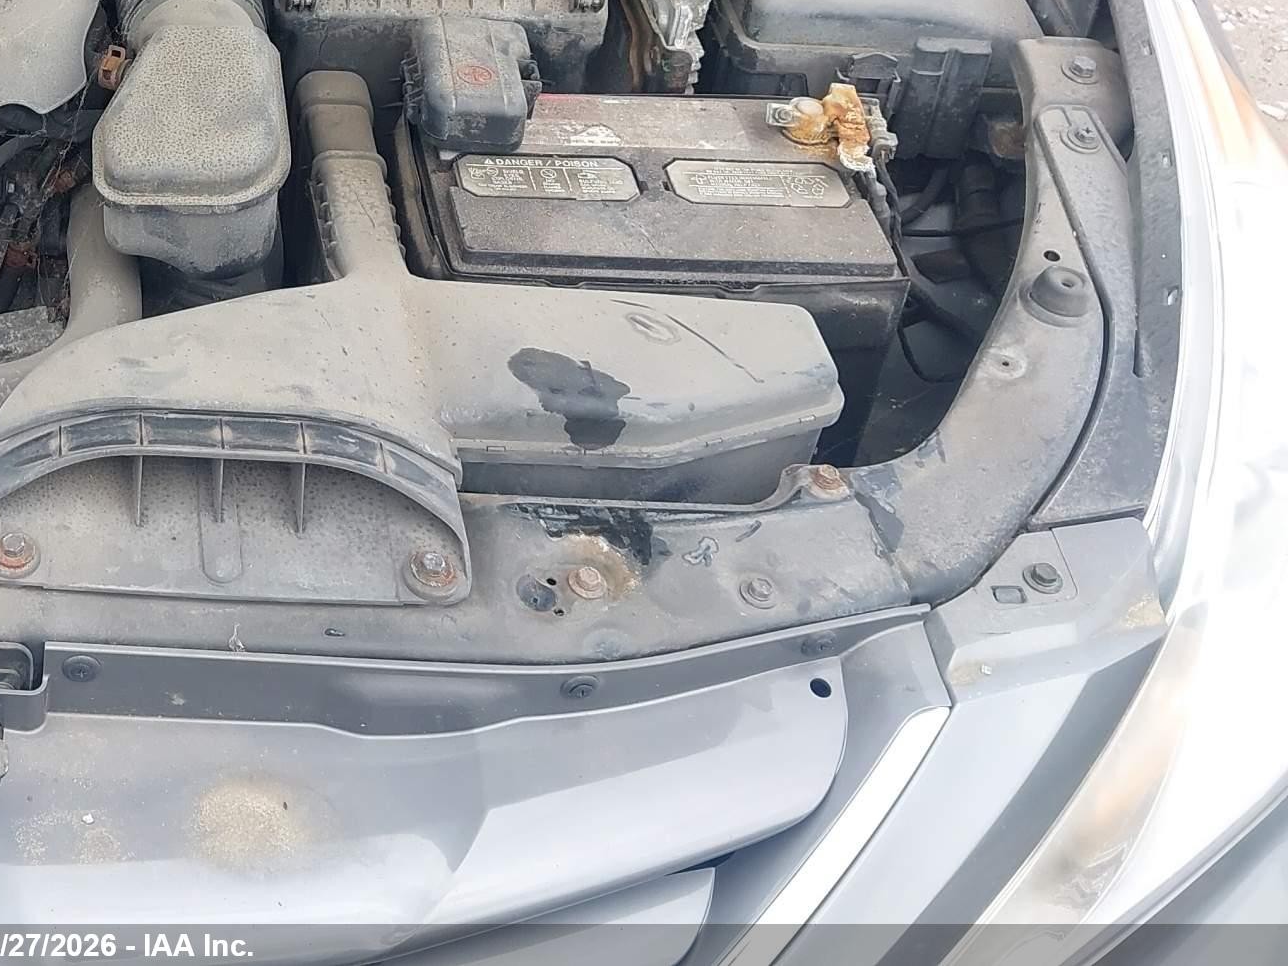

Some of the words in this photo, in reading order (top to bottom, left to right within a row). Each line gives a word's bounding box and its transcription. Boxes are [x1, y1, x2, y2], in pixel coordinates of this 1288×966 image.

[495, 158, 543, 167] DANGER
[545, 159, 552, 167] /
[554, 159, 599, 168] POISON
